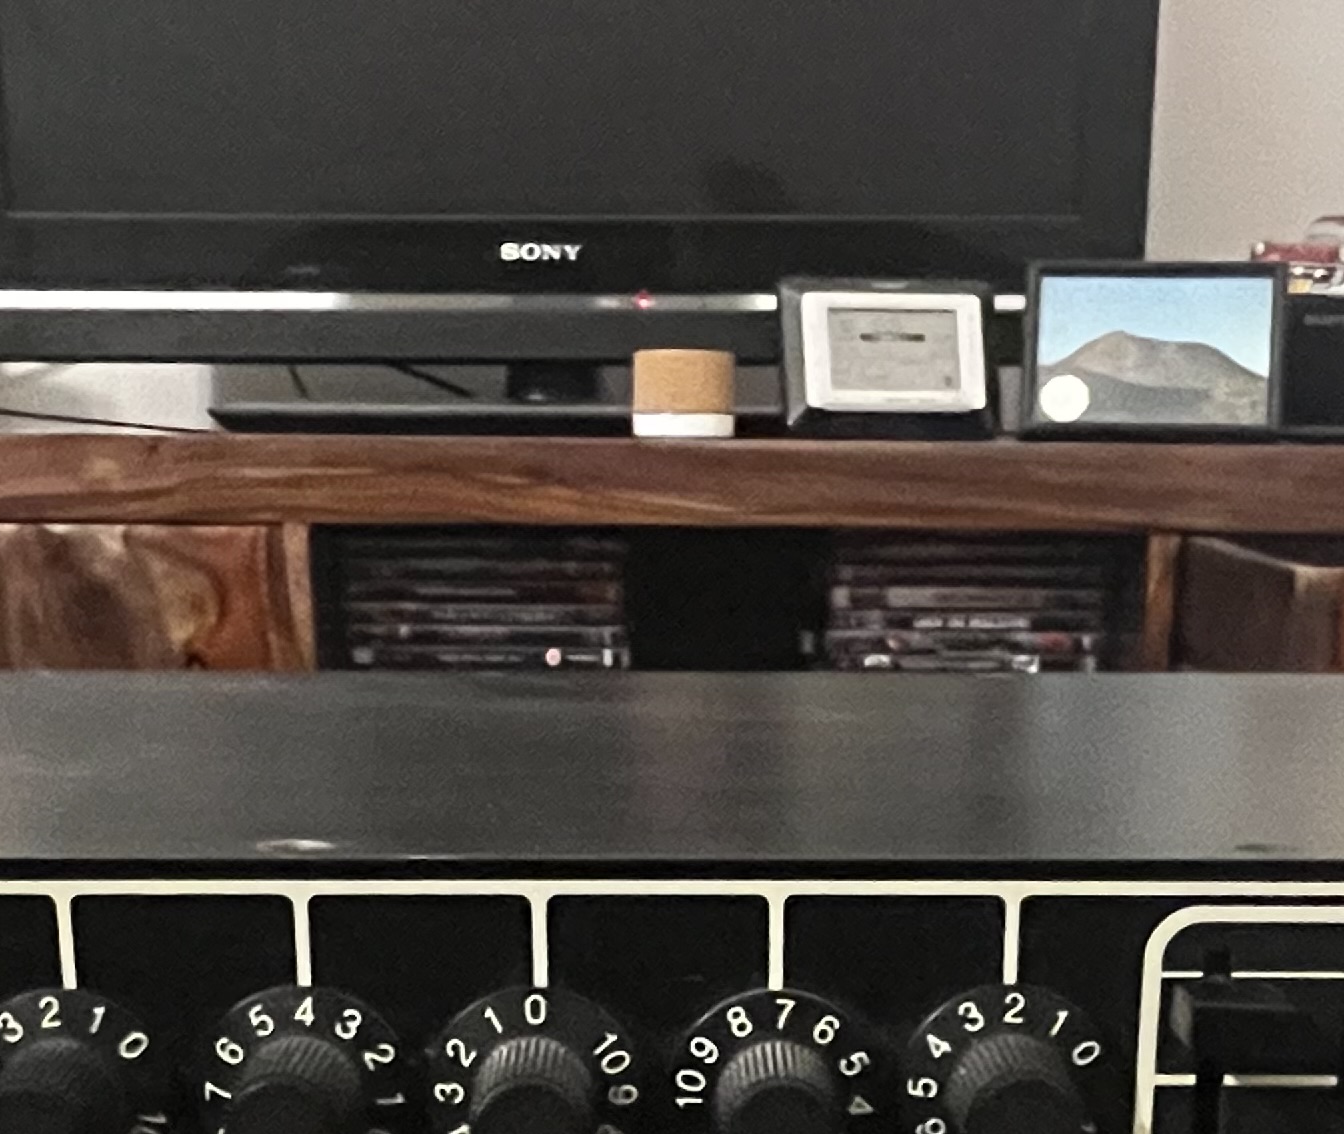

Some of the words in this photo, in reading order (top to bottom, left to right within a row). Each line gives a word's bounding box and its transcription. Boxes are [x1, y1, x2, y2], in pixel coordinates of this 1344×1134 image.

[500, 242, 582, 261] SONY
[248, 1004, 275, 1038] 5
[293, 996, 316, 1027] 4
[334, 1008, 362, 1040] 3
[484, 1006, 504, 1034] 1
[524, 994, 547, 1026] 0
[726, 1006, 754, 1038] 8
[775, 998, 796, 1030] 7
[38, 996, 62, 1029] 2
[89, 1006, 106, 1034] 1
[118, 1031, 150, 1060] 0
[812, 1014, 840, 1045] 6
[215, 1036, 244, 1066] 6
[364, 1042, 396, 1072] 2
[446, 1038, 477, 1068] 2
[592, 1032, 631, 1075] 10
[689, 1036, 719, 1064] 9
[906, 1076, 939, 1099] 5
[926, 1033, 952, 1059] 4
[958, 1001, 985, 1033] 3
[1002, 992, 1026, 1024] 2
[1049, 1010, 1069, 1037] 1
[1071, 1040, 1101, 1066] 0
[838, 1051, 871, 1076] 5
[204, 1080, 232, 1102] 7
[434, 1082, 465, 1104] 3
[674, 1067, 707, 1110] 10
